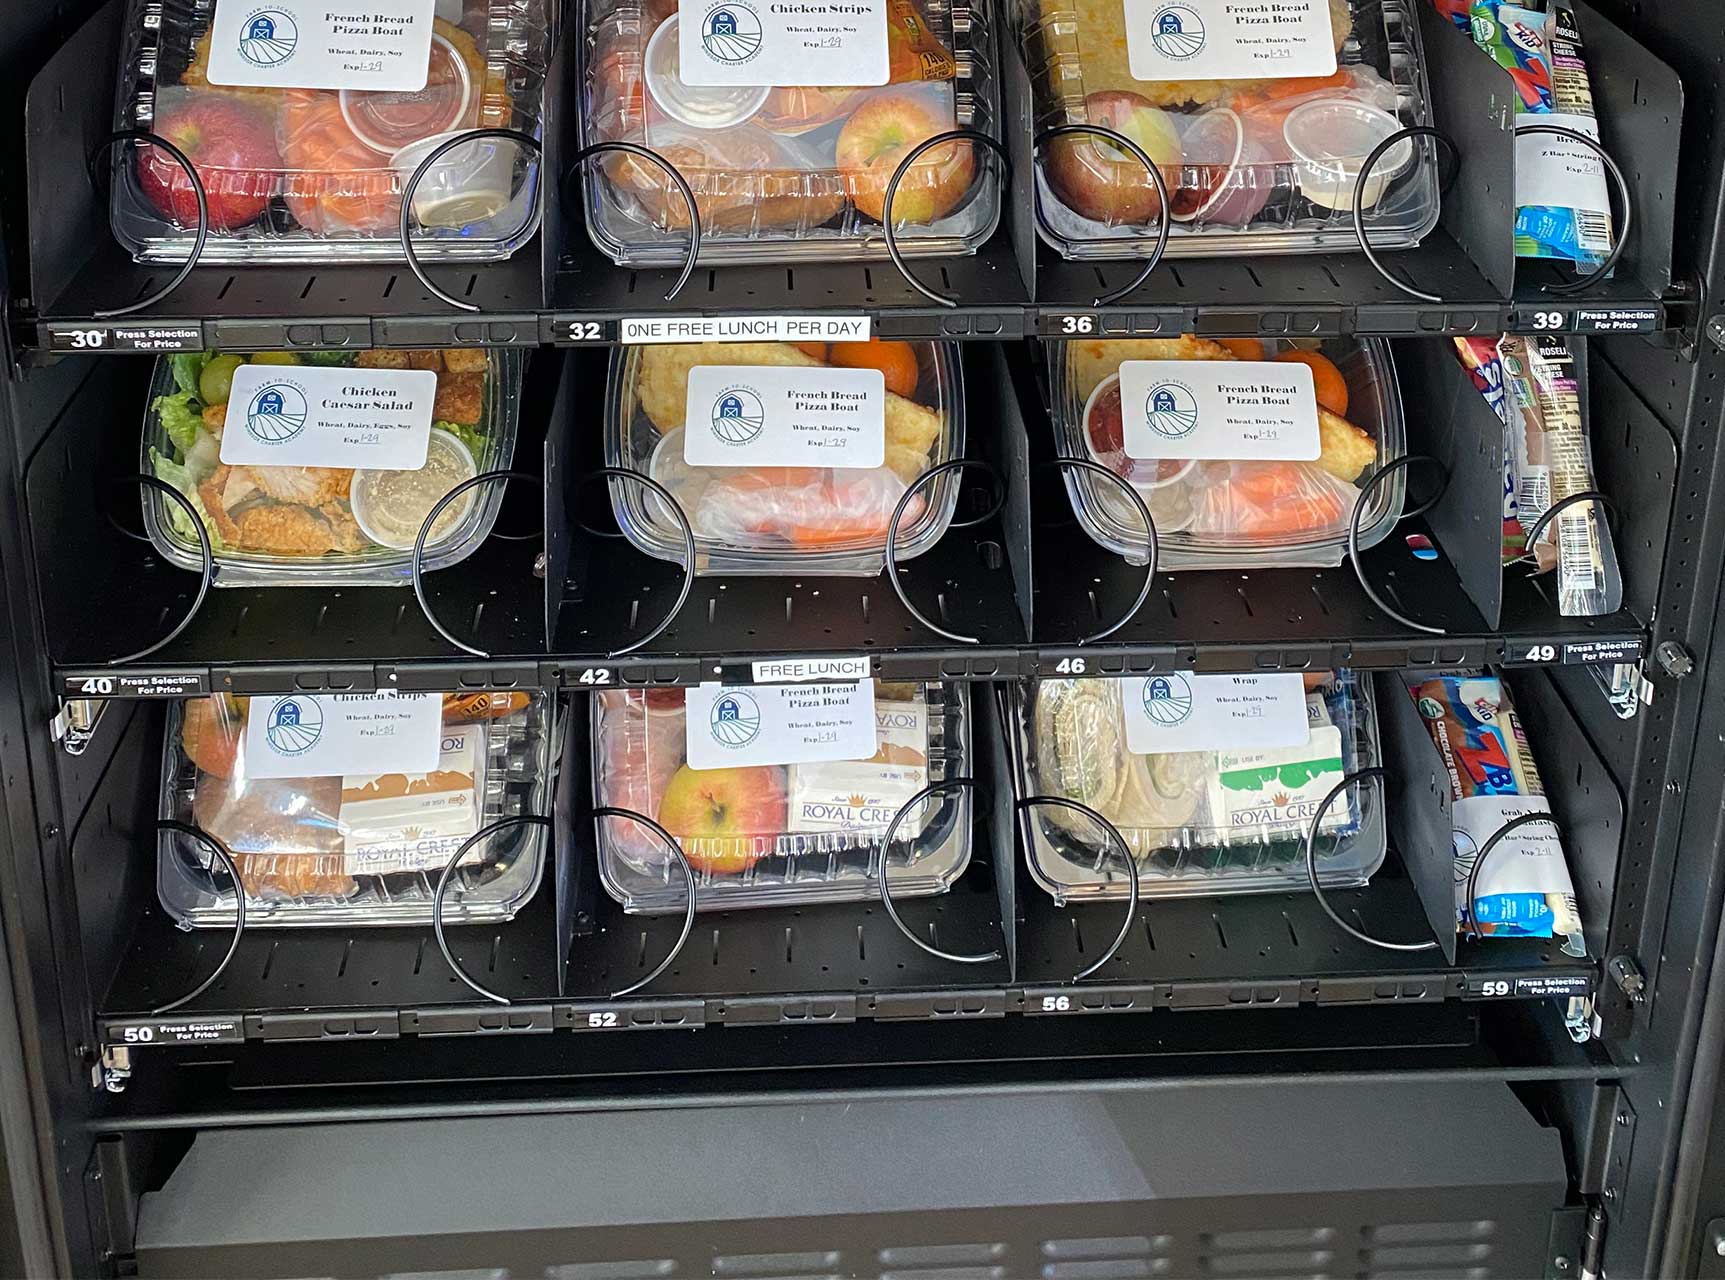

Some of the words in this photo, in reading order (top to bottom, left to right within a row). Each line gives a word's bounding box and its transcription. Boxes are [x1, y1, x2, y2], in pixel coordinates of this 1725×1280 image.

[770, 4, 827, 14] Chicken
[829, 4, 872, 15] Strips
[1225, 4, 1269, 14] French
[1271, 3, 1310, 12] Bread
[325, 13, 370, 23] French
[373, 14, 414, 24] Bread
[1235, 16, 1270, 25] Pizza
[1272, 15, 1302, 24] Boat
[332, 25, 368, 35] Pizza
[372, 26, 403, 36] Boat
[1556, 26, 1579, 40] ROSELI
[1532, 311, 1563, 330] 39
[1580, 311, 1608, 320] Press
[1609, 311, 1655, 320] Selection
[667, 322, 713, 336] FREE
[718, 320, 778, 336] LUNCH
[786, 321, 822, 335] PER
[827, 321, 862, 335] DAY
[1062, 316, 1093, 334] 36
[1594, 321, 1612, 330] For
[1612, 321, 1639, 329] Price
[115, 330, 147, 339] Press
[148, 329, 198, 338] Selection
[569, 322, 601, 340] 32
[70, 330, 104, 348] 30
[134, 340, 152, 349] For
[153, 339, 182, 348] Price
[1539, 347, 1567, 356] ROSELI
[341, 386, 397, 397] Chicken
[1217, 384, 1258, 393] French
[1260, 385, 1297, 394] Bread
[787, 390, 828, 399] French
[831, 391, 867, 400] Bread
[1226, 396, 1259, 405] Pizza
[1262, 396, 1290, 405] Boat
[321, 399, 370, 410] Caesar
[372, 400, 413, 410] Salad
[795, 401, 828, 411] Pizza
[830, 402, 858, 412] Boat
[1567, 643, 1594, 653] Press
[1595, 641, 1639, 651] Selection
[1525, 645, 1555, 662] 49
[1581, 653, 1598, 661] For
[1598, 651, 1624, 659] Price
[759, 664, 804, 677] FREE
[808, 662, 865, 675] LUNCH
[1055, 657, 1086, 674] 46
[120, 678, 149, 686] Press
[150, 675, 198, 685] Selection
[579, 668, 611, 685] 42
[1232, 677, 1258, 685] Wrap
[81, 678, 113, 694] 40
[137, 686, 155, 695] For
[156, 685, 183, 694] Price
[780, 687, 820, 697] French
[822, 684, 857, 695] Bread
[789, 699, 821, 709] Pizza
[822, 697, 850, 706] Boat
[802, 804, 856, 821] ROYAL
[1231, 807, 1286, 828] ROYAL
[1286, 801, 1337, 819] CRET
[1518, 978, 1543, 987] Press
[1544, 976, 1588, 986] Selection
[1481, 980, 1509, 996] 59
[1547, 986, 1571, 994] Price
[1042, 995, 1070, 1012] 56
[588, 1012, 617, 1028] 52
[159, 1025, 187, 1033] Press
[188, 1021, 235, 1032] Selection
[124, 1026, 153, 1042] 50
[176, 1032, 193, 1040] For
[193, 1031, 220, 1041] Price
